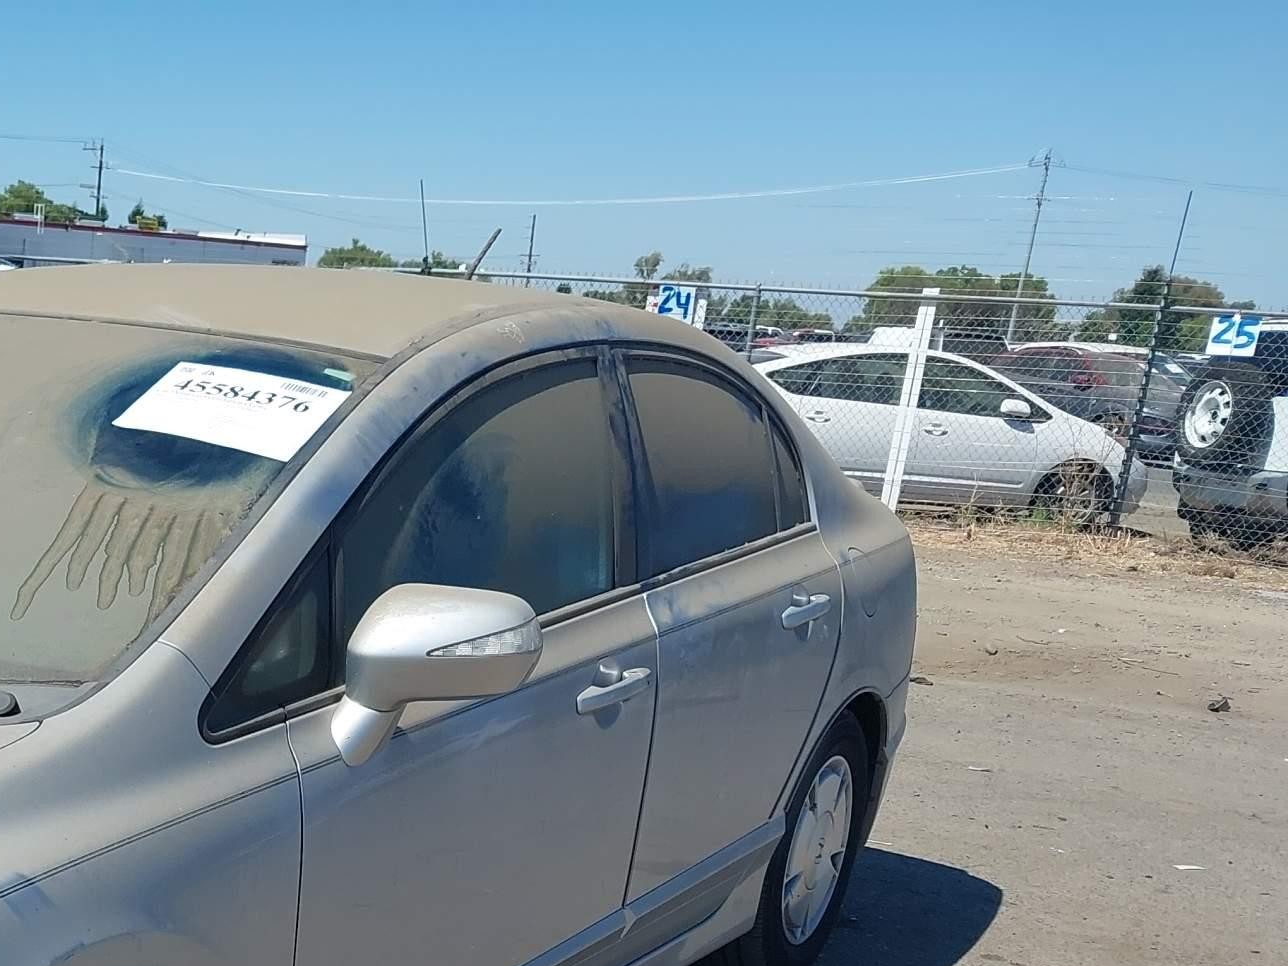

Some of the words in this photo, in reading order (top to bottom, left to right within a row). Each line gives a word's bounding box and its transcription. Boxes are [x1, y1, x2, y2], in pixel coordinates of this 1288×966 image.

[658, 286, 692, 320] 24
[1211, 313, 1261, 348] 25
[173, 378, 311, 413] 45584376
